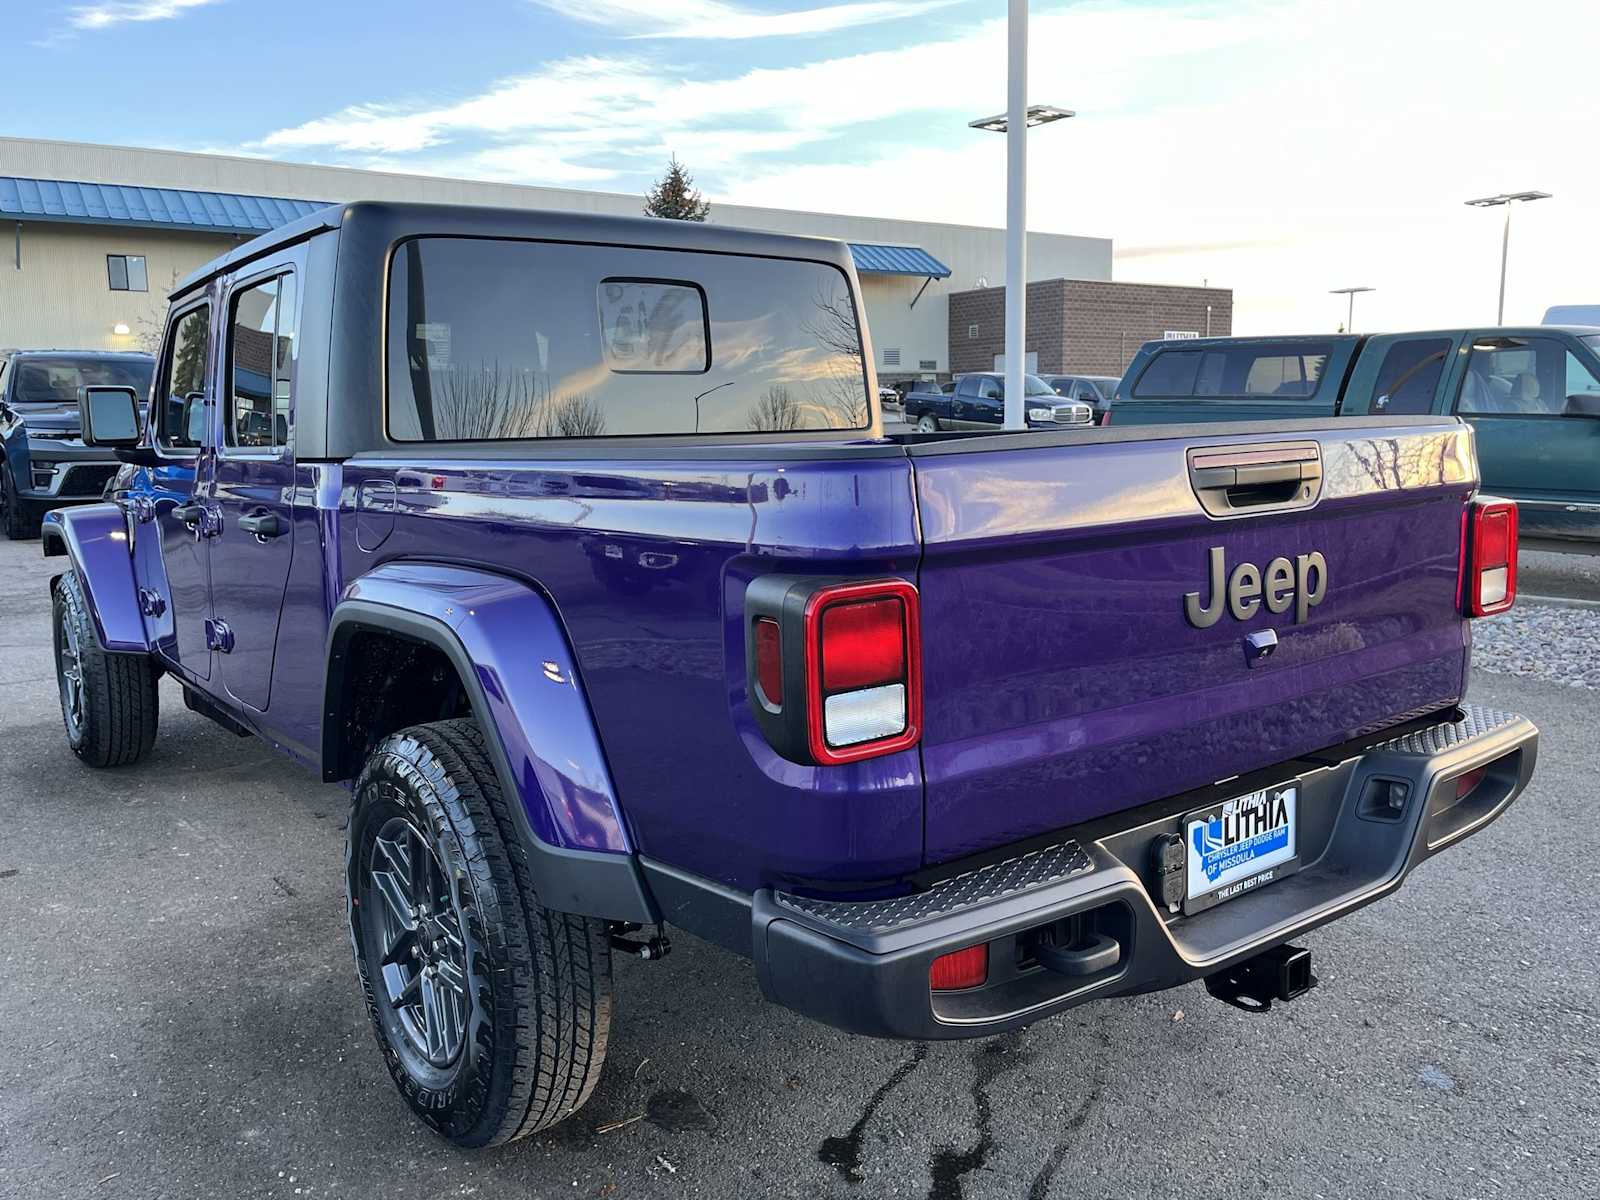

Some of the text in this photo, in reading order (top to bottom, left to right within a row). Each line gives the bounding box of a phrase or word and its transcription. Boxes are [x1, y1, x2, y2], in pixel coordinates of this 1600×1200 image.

[1183, 547, 1328, 629] Jeep
[1224, 798, 1289, 847] LITHIA
[1207, 828, 1286, 863] CHRYSLER JEEP DODGE RAM
[1207, 849, 1255, 876] OF MISSOULA
[1218, 870, 1274, 900] THE LAST BEST PRICE
